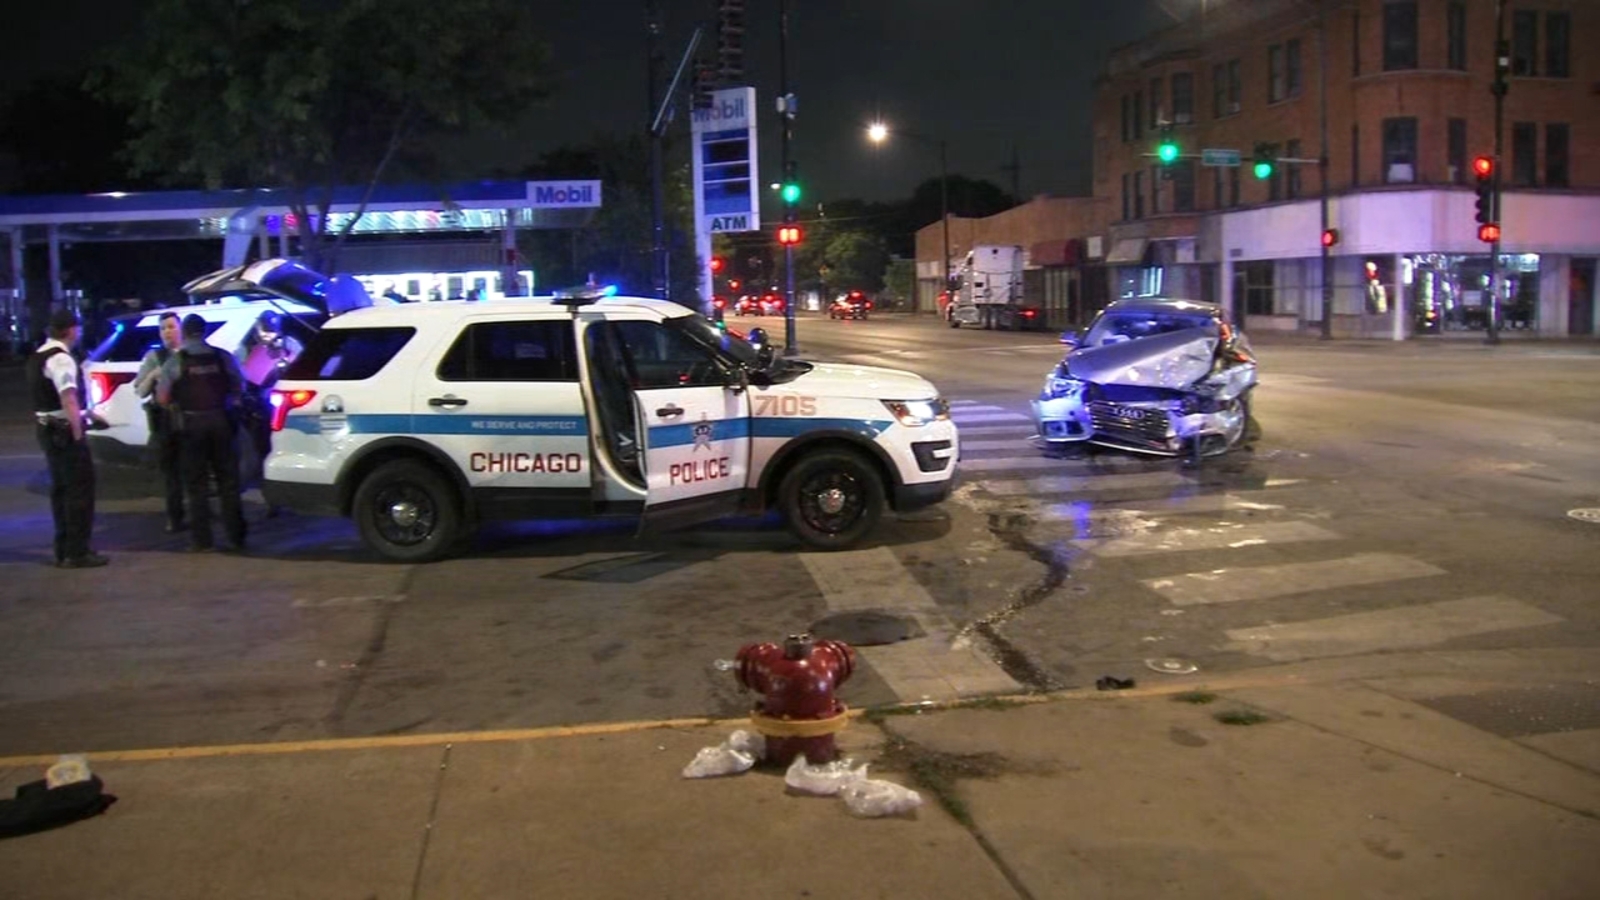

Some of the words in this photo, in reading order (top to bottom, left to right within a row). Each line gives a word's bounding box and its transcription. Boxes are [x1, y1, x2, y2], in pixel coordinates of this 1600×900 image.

[694, 98, 744, 122] Mobil
[536, 185, 592, 203] Mobil
[711, 216, 747, 231] ATM
[754, 396, 816, 416] 7105
[537, 420, 577, 430] PROTECT
[470, 452, 581, 472] CHICAGO
[670, 457, 730, 486] POLICE
